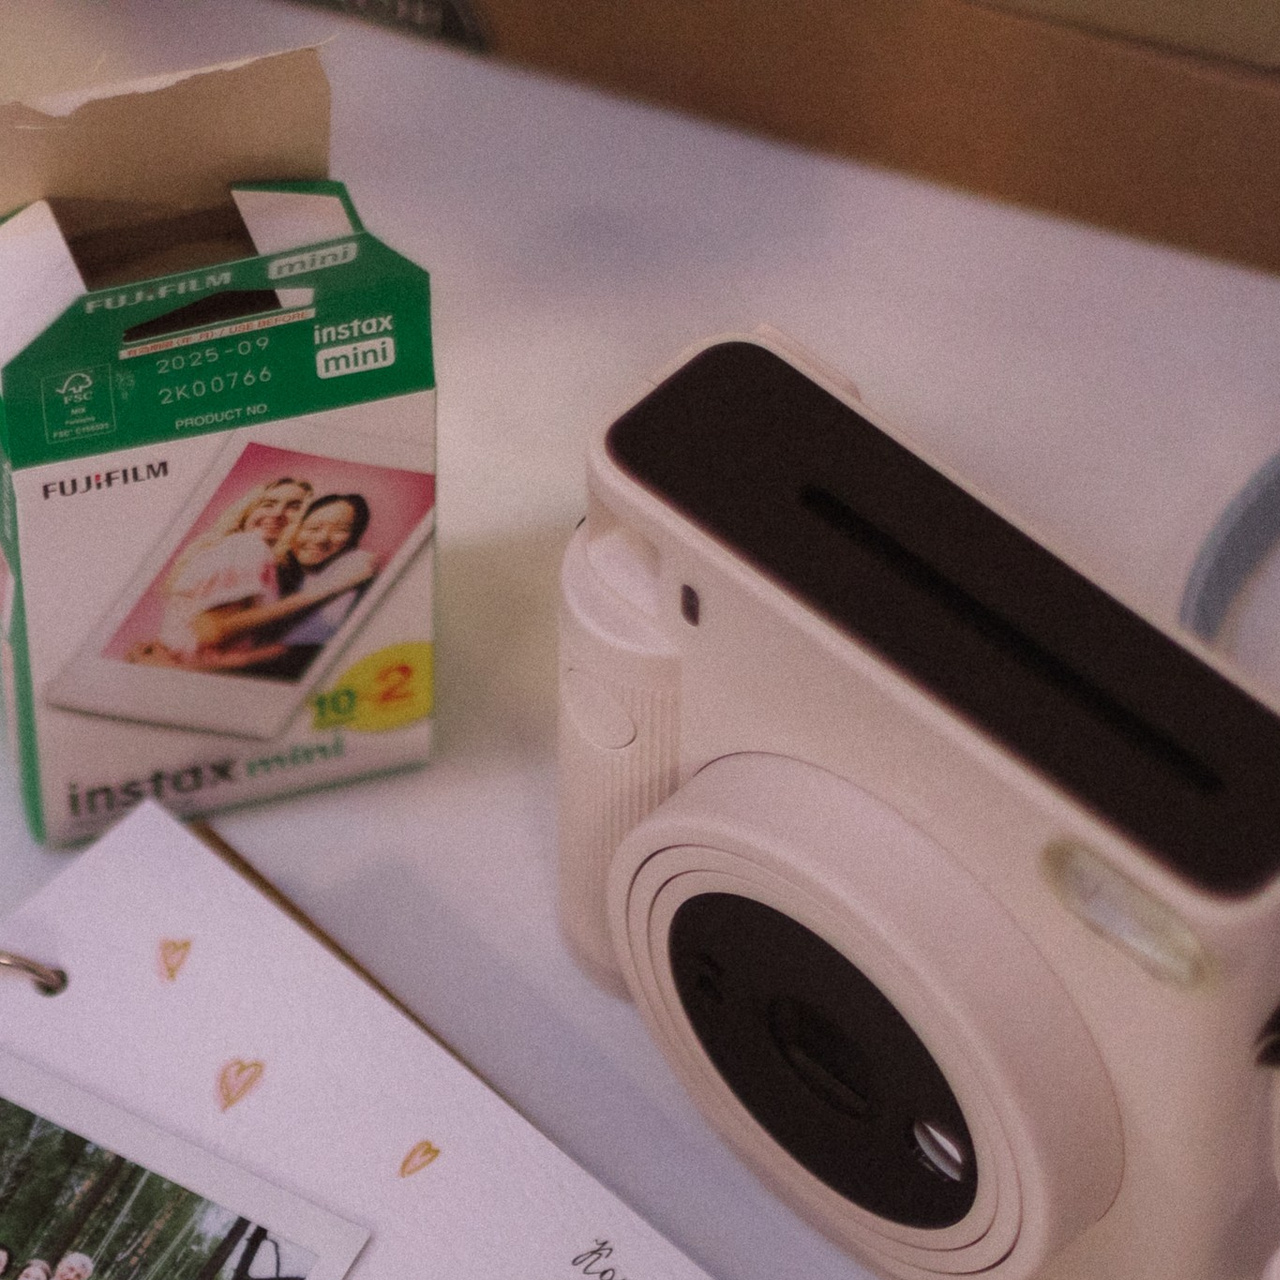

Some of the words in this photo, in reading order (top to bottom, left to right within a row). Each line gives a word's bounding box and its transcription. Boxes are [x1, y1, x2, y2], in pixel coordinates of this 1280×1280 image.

[84, 271, 233, 314] FUJIFILM
[276, 246, 352, 276] mini
[313, 315, 394, 345] instax
[156, 337, 270, 375] 2025-09
[322, 341, 389, 373] mini
[158, 366, 273, 405] 2K00766
[175, 408, 244, 430] PRODUCT
[42, 461, 169, 500] FUJIFILM
[68, 759, 238, 817] instax
